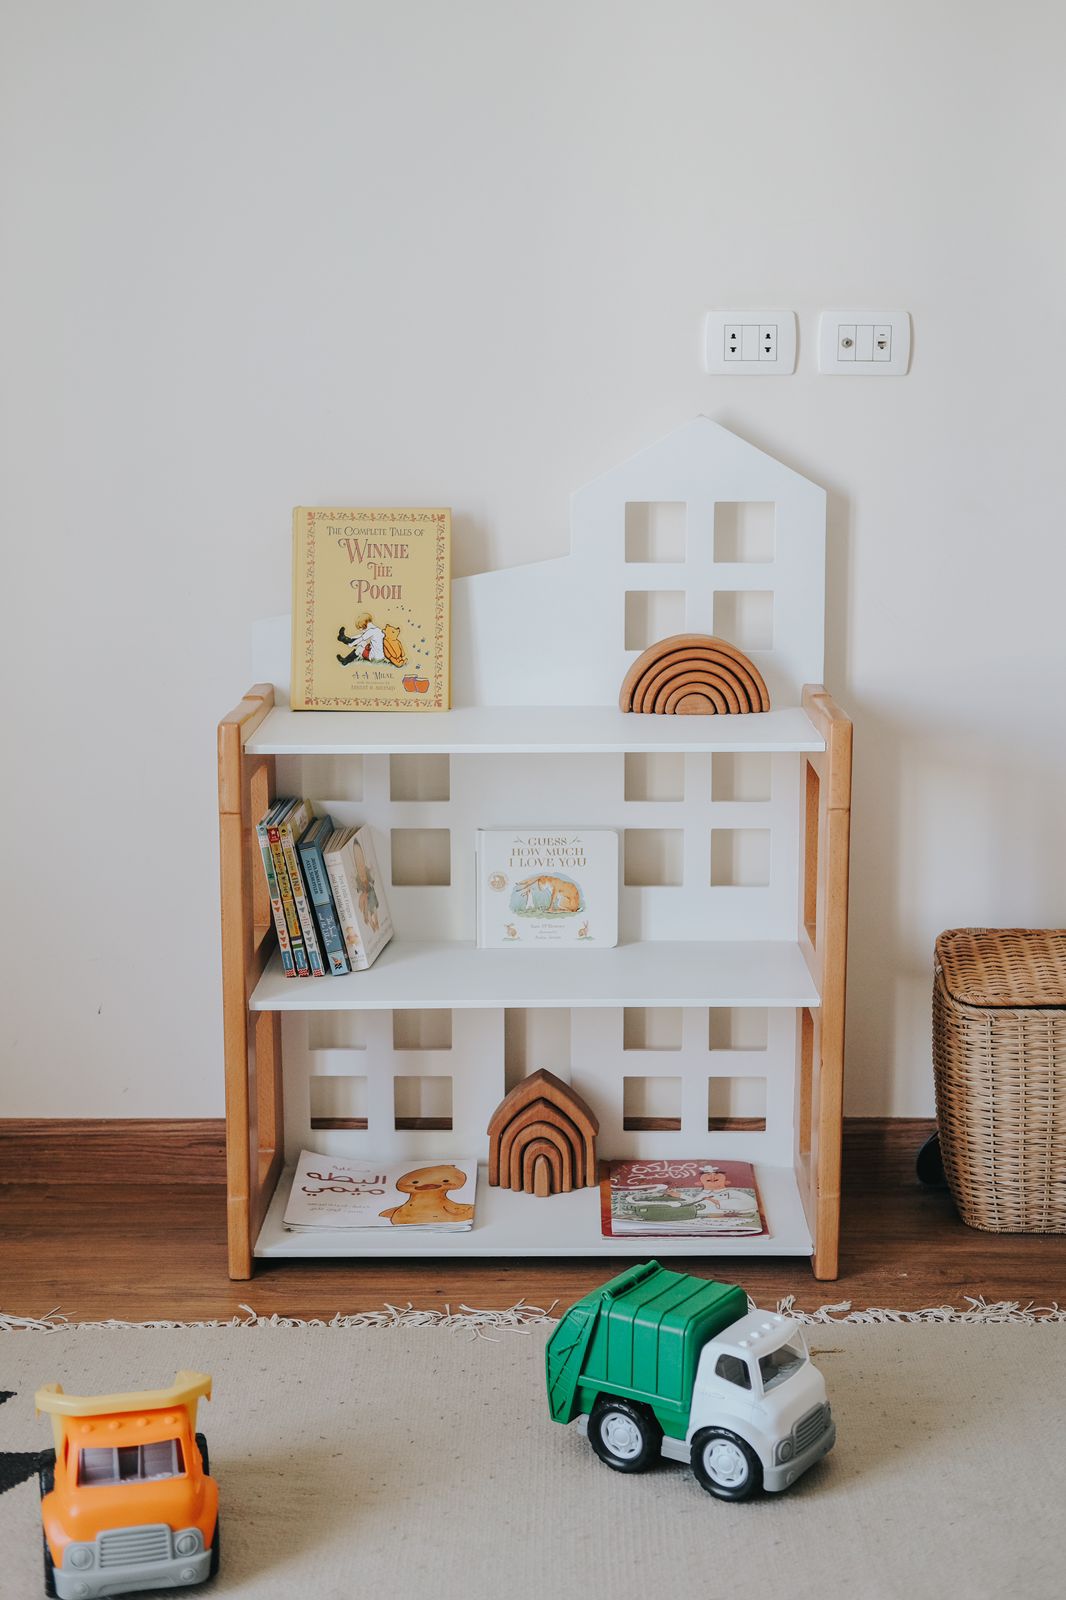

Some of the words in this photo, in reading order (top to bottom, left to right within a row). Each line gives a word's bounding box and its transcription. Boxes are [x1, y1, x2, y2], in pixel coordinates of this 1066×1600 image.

[338, 538, 409, 564] WINNIE
[366, 561, 393, 580] THE
[350, 579, 402, 604] POOH
[528, 837, 567, 846] GUESS
[512, 847, 540, 856] HOW
[546, 847, 584, 856] MUCH
[520, 858, 555, 867] LOVE
[559, 858, 587, 867] YOU
